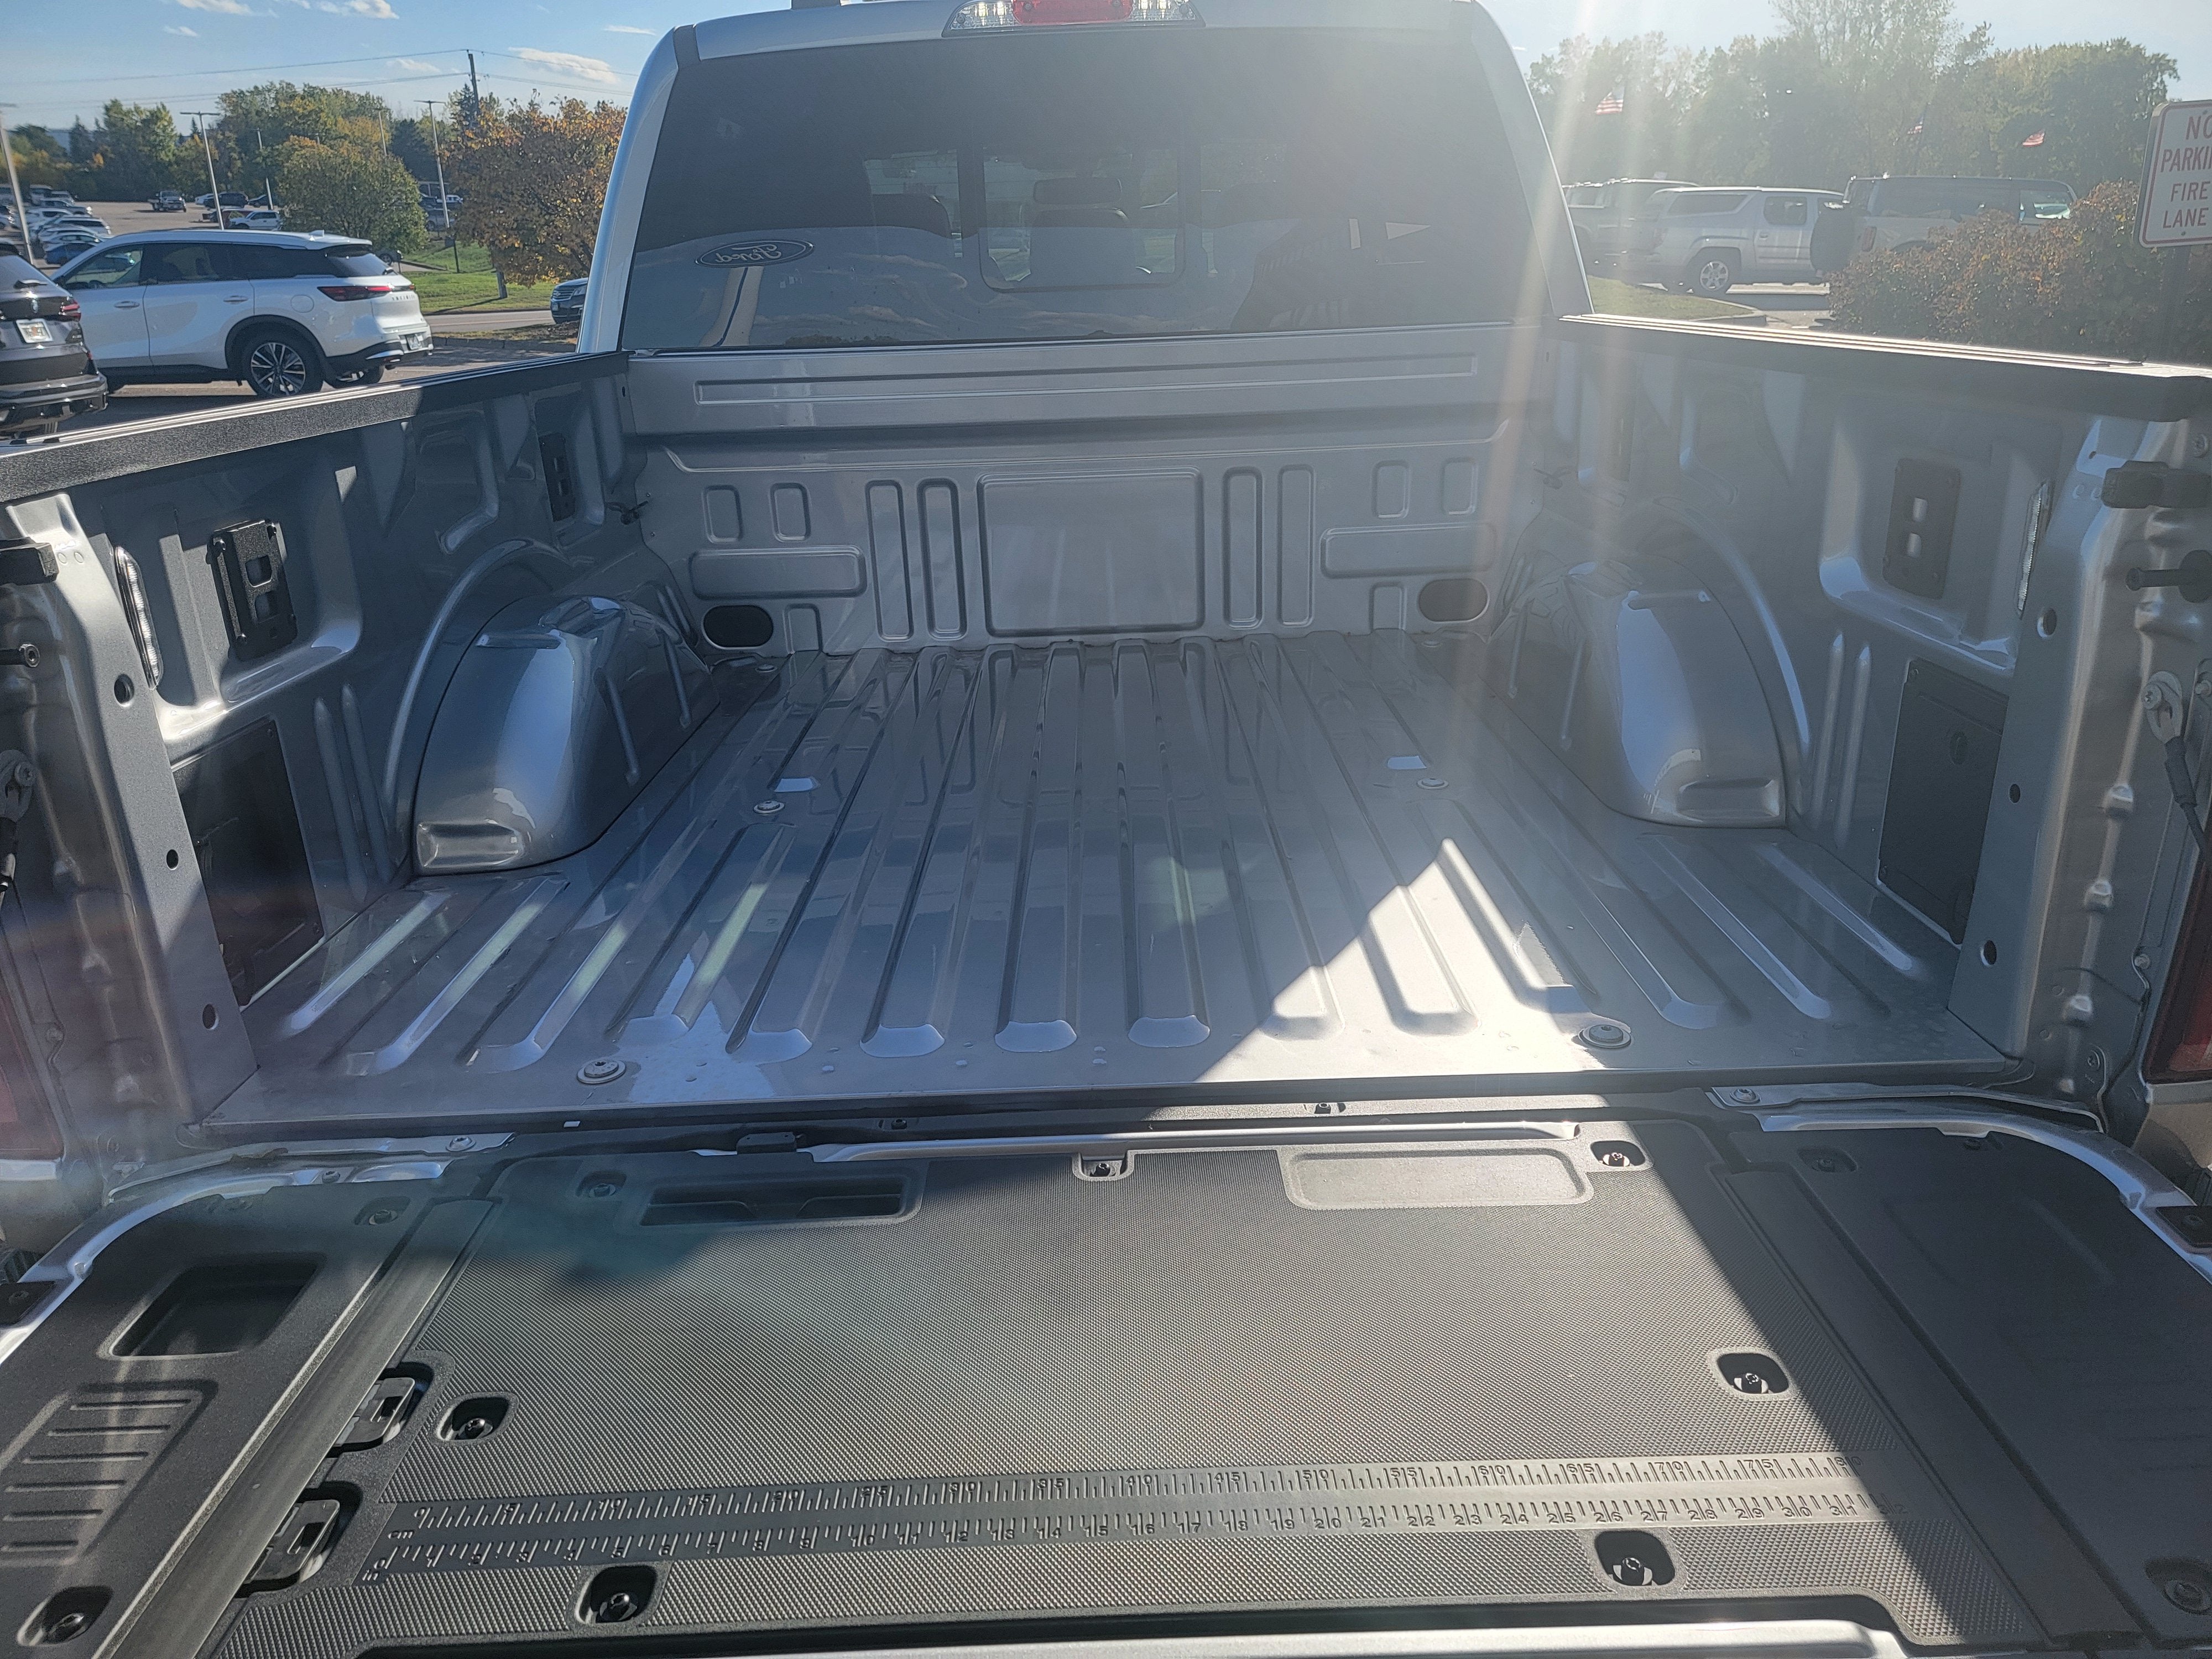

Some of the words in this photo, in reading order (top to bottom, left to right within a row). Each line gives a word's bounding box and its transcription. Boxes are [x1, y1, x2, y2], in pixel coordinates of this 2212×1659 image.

[2185, 114, 2212, 139] NO
[2171, 181, 2210, 202] FIRE
[2163, 207, 2209, 228] LANE
[414, 1506, 426, 1519] 0
[503, 1503, 517, 1514] 5
[598, 1498, 622, 1510] 10
[688, 1494, 710, 1505] 15
[771, 1490, 799, 1502] 20
[860, 1486, 888, 1497] 25
[949, 1481, 977, 1493] 30
[1036, 1478, 1064, 1489] 35
[1126, 1475, 1152, 1486] 40
[1214, 1472, 1240, 1483] 45
[1302, 1469, 1328, 1480] 50
[1390, 1467, 1417, 1478] 55
[1479, 1465, 1505, 1476] 60
[1567, 1463, 1594, 1474] 65
[1655, 1461, 1683, 1472] 70
[1744, 1459, 1773, 1470] 75
[1834, 1457, 1863, 1466] 80
[374, 1558, 386, 1569] 0
[427, 1556, 435, 1567] 1
[611, 1547, 624, 1558] 5
[658, 1544, 671, 1556] 6
[706, 1543, 718, 1554] 7
[753, 1541, 764, 1552] 8
[800, 1537, 812, 1549] 9
[850, 1535, 875, 1547] 10
[897, 1533, 919, 1545] 11
[944, 1531, 968, 1543] 12
[990, 1528, 1014, 1541] 13
[1037, 1527, 1061, 1539] 14
[1084, 1525, 1108, 1537] 15
[1130, 1524, 1155, 1536] 16
[1177, 1522, 1201, 1534] 17
[1224, 1520, 1248, 1532] 18
[1270, 1519, 1295, 1531] 19
[1314, 1517, 1342, 1530] 20
[1360, 1516, 1385, 1528] 21
[1407, 1516, 1436, 1527] 22
[1454, 1515, 1481, 1526] 23
[1501, 1514, 1528, 1525] 24
[1548, 1512, 1575, 1524] 25
[1594, 1511, 1623, 1522] 26
[1641, 1511, 1667, 1521] 27
[1688, 1509, 1717, 1521] 28
[1735, 1507, 1765, 1519] 29
[1782, 1506, 1812, 1517] 30
[1829, 1505, 1858, 1516] 31
[388, 1530, 414, 1540] cm
[363, 1569, 379, 1581] in
